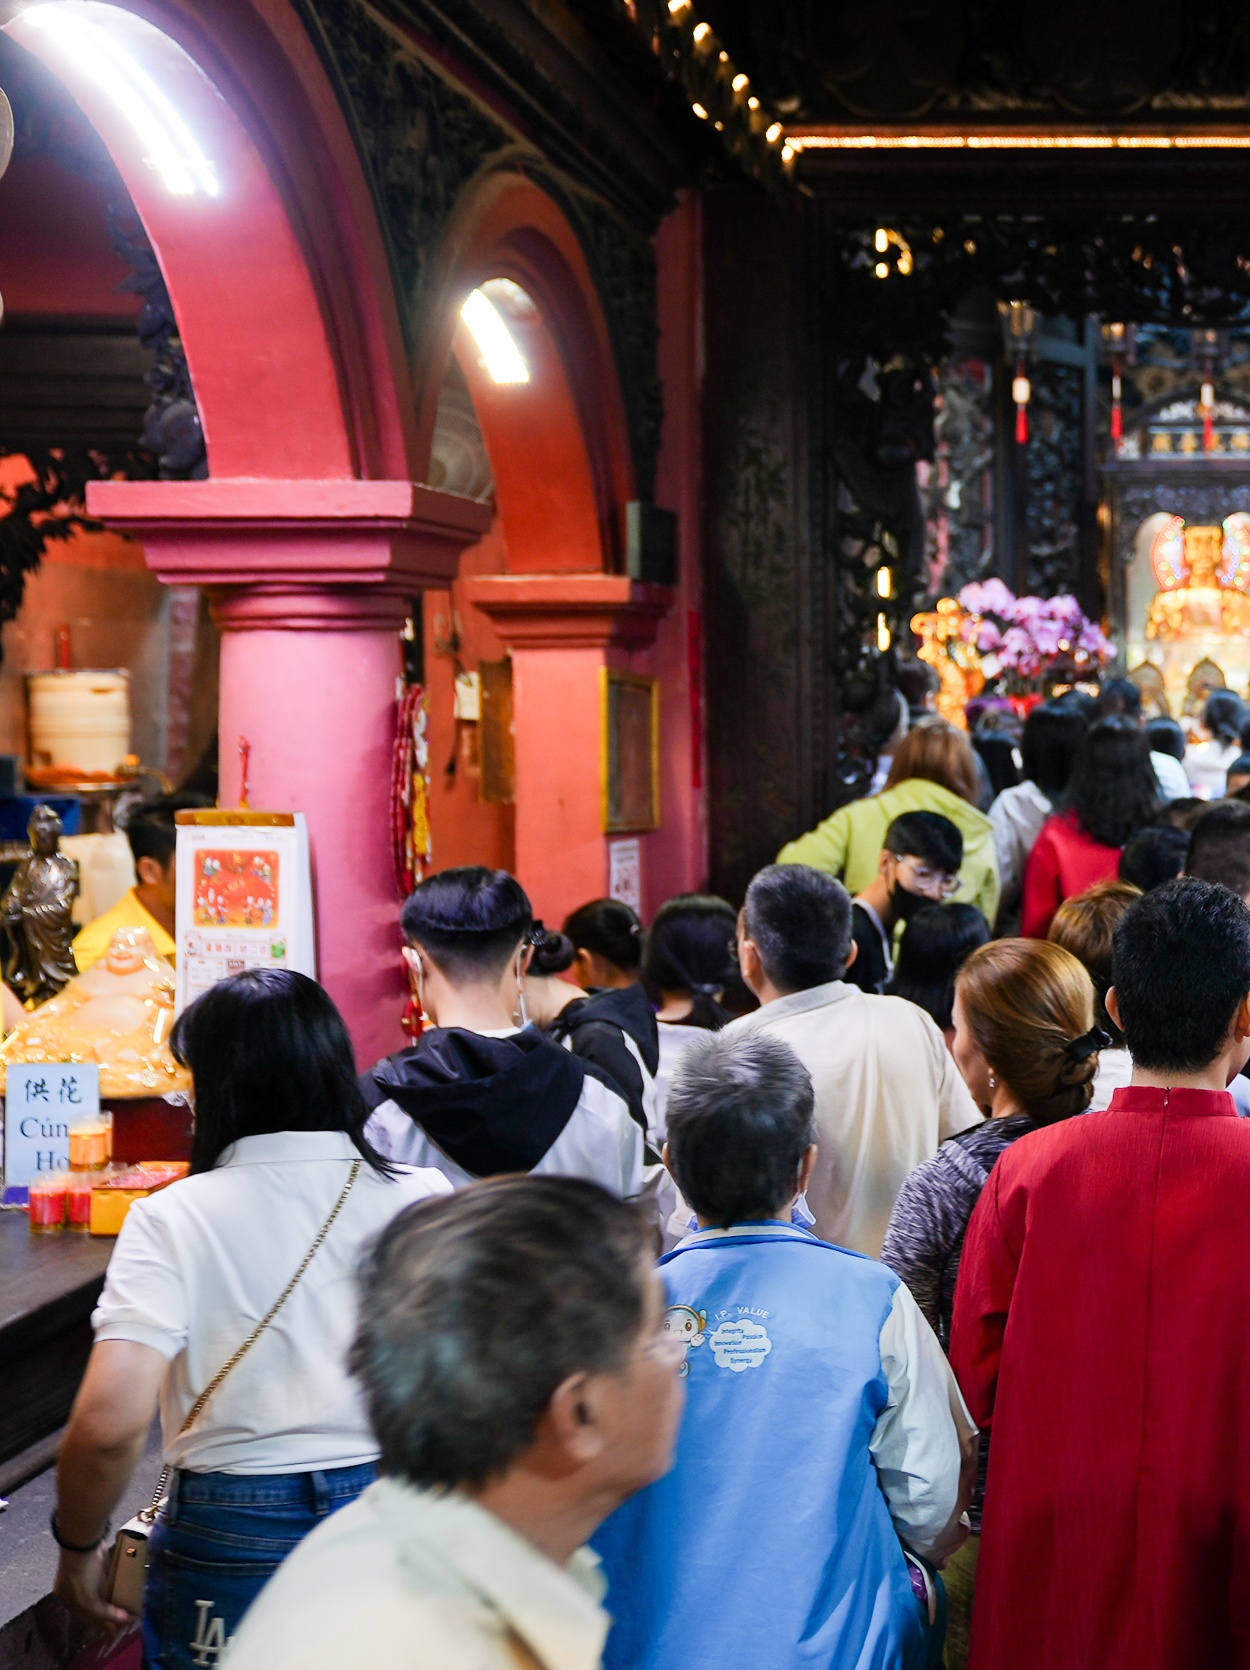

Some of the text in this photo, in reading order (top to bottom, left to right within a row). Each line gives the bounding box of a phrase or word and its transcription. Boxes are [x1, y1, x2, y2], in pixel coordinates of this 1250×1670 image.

[25, 1075, 83, 1104] 供花
[20, 1116, 69, 1139] Cún
[36, 1151, 70, 1171] Ho
[736, 1306, 770, 1319] VALUE
[190, 1600, 236, 1668] LA
